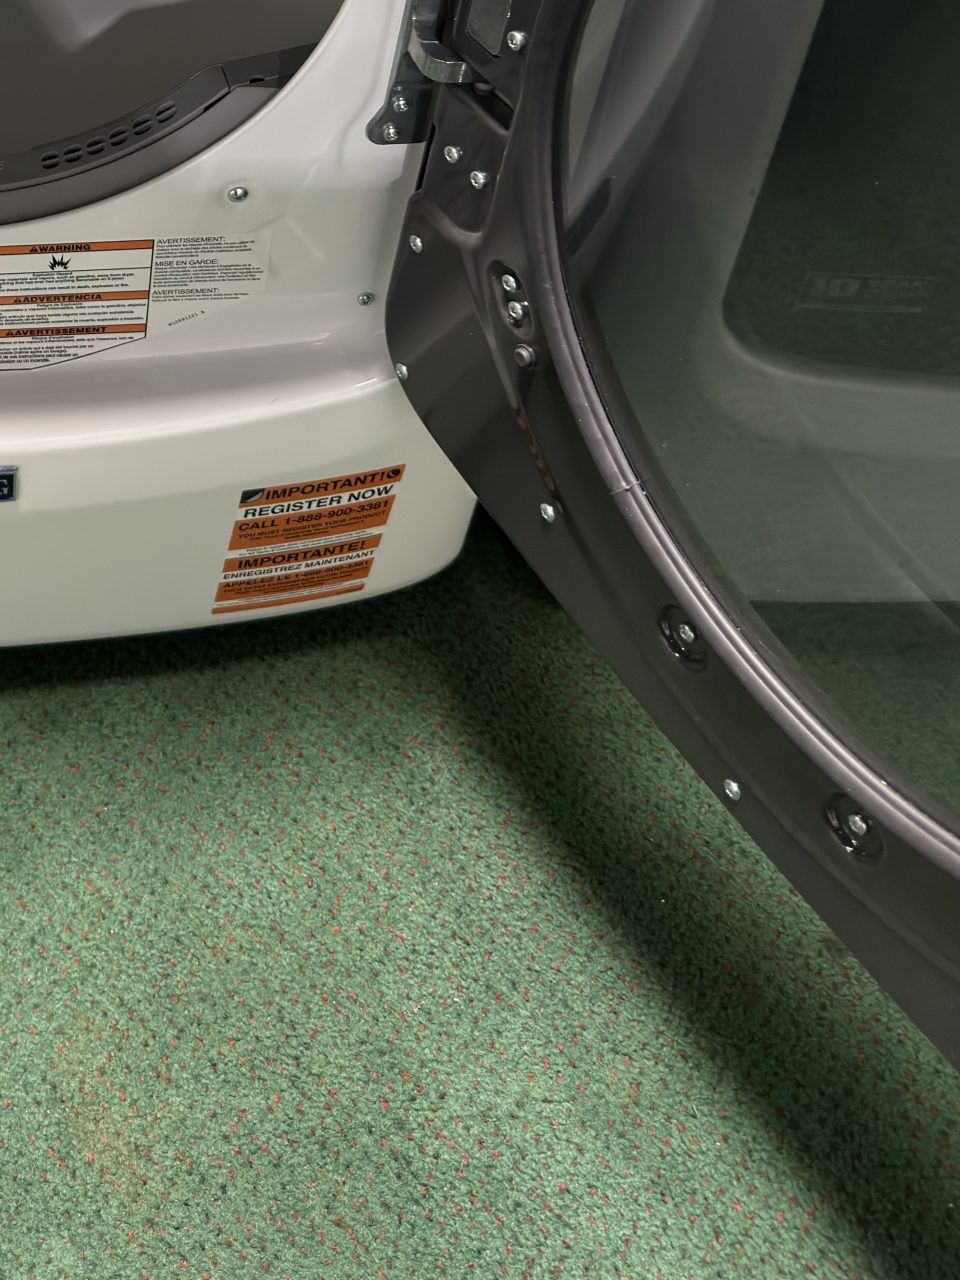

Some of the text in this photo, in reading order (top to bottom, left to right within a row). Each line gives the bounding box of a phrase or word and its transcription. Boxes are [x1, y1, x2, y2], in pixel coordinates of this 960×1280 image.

[38, 244, 90, 252] WARNING
[156, 236, 226, 244] AVERTISSEMENT:
[23, 293, 102, 303] ADVERTENCIA
[15, 326, 107, 336] AVERTISSEMENT
[264, 471, 385, 500] IMPORTANT!
[242, 484, 394, 518] REGISTER NOW
[238, 519, 278, 532] CALL
[285, 500, 389, 526] 1-888-900-3381
[222, 550, 376, 580] ENREGISTREZ MAINTENANT
[238, 540, 366, 569] IMPORTANTE!
